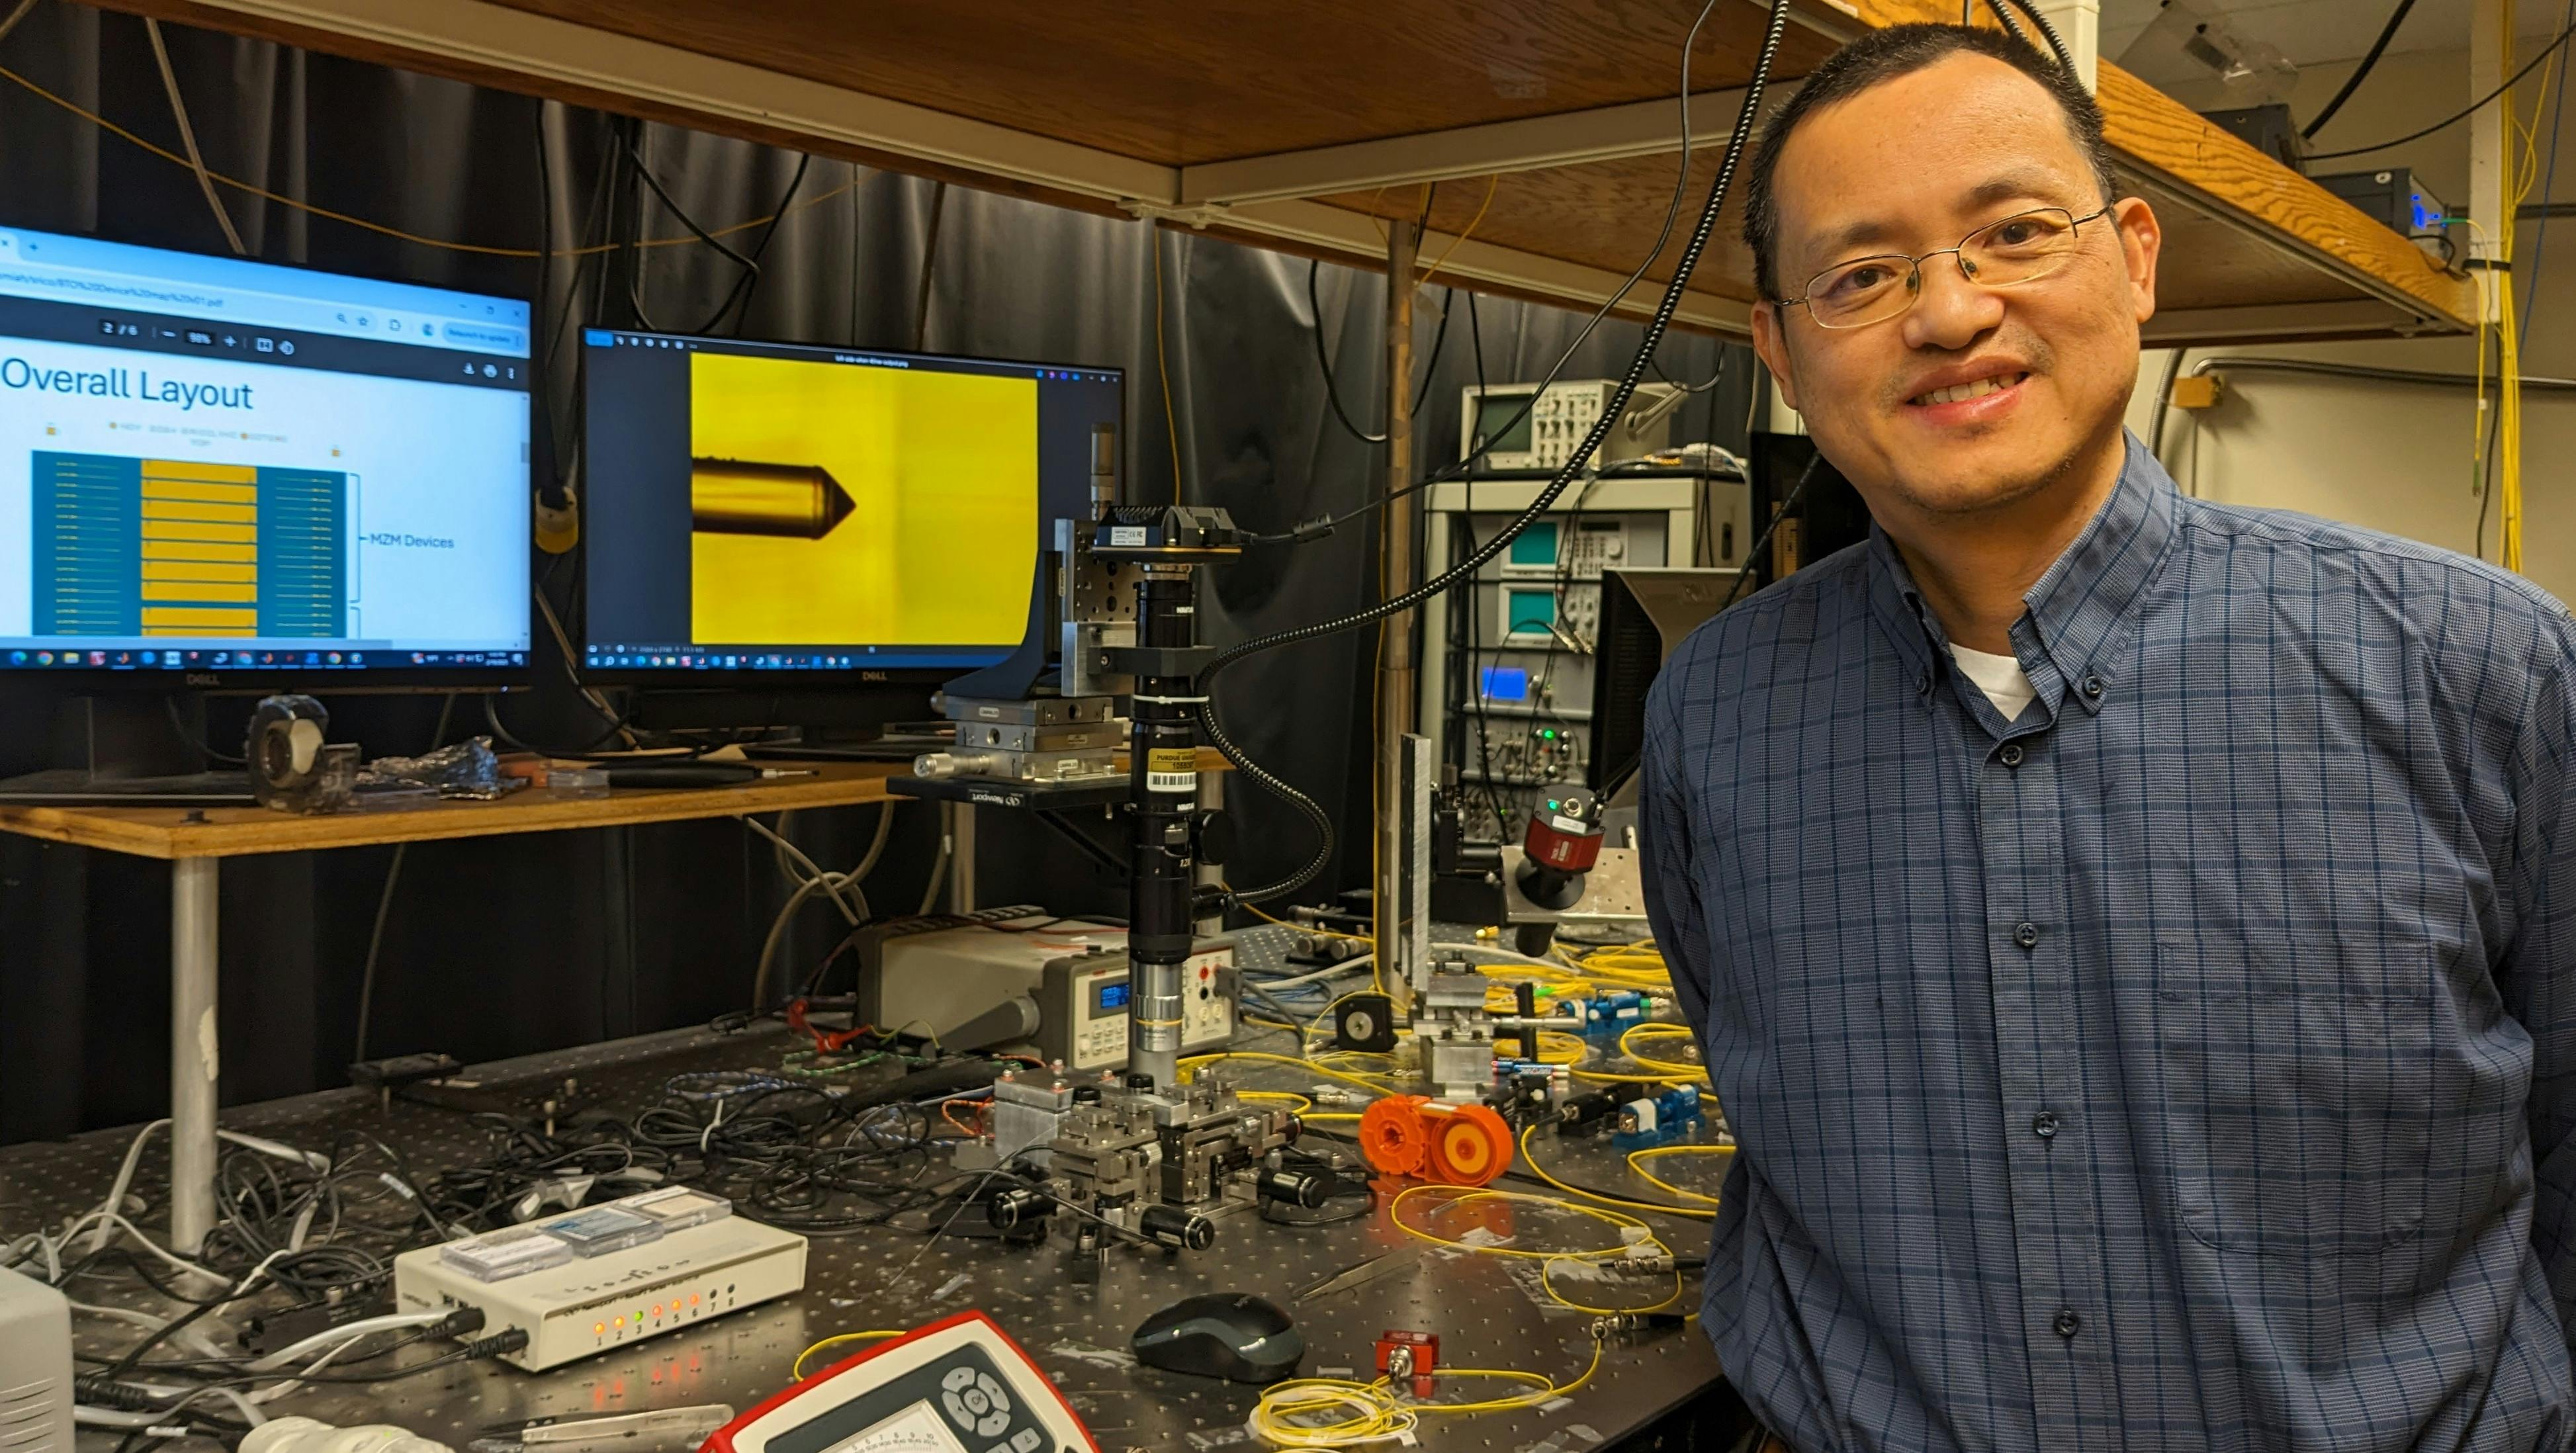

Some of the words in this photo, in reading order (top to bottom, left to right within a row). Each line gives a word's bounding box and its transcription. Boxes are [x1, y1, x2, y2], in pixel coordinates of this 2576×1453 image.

[1, 358, 131, 398] Overall
[141, 371, 253, 411] Layout
[370, 533, 402, 546] MZM
[404, 534, 455, 549] Devices
[187, 674, 220, 685] DELL
[862, 671, 888, 682] DELL
[597, 1337, 602, 1346] 1
[617, 1331, 622, 1341] 2
[636, 1325, 642, 1335] 3
[655, 1319, 661, 1328] 4
[674, 1313, 680, 1323] 5
[692, 1308, 698, 1317] 6
[710, 1302, 716, 1311] 7
[729, 1297, 734, 1306] 8
[971, 1394, 985, 1405] OK
